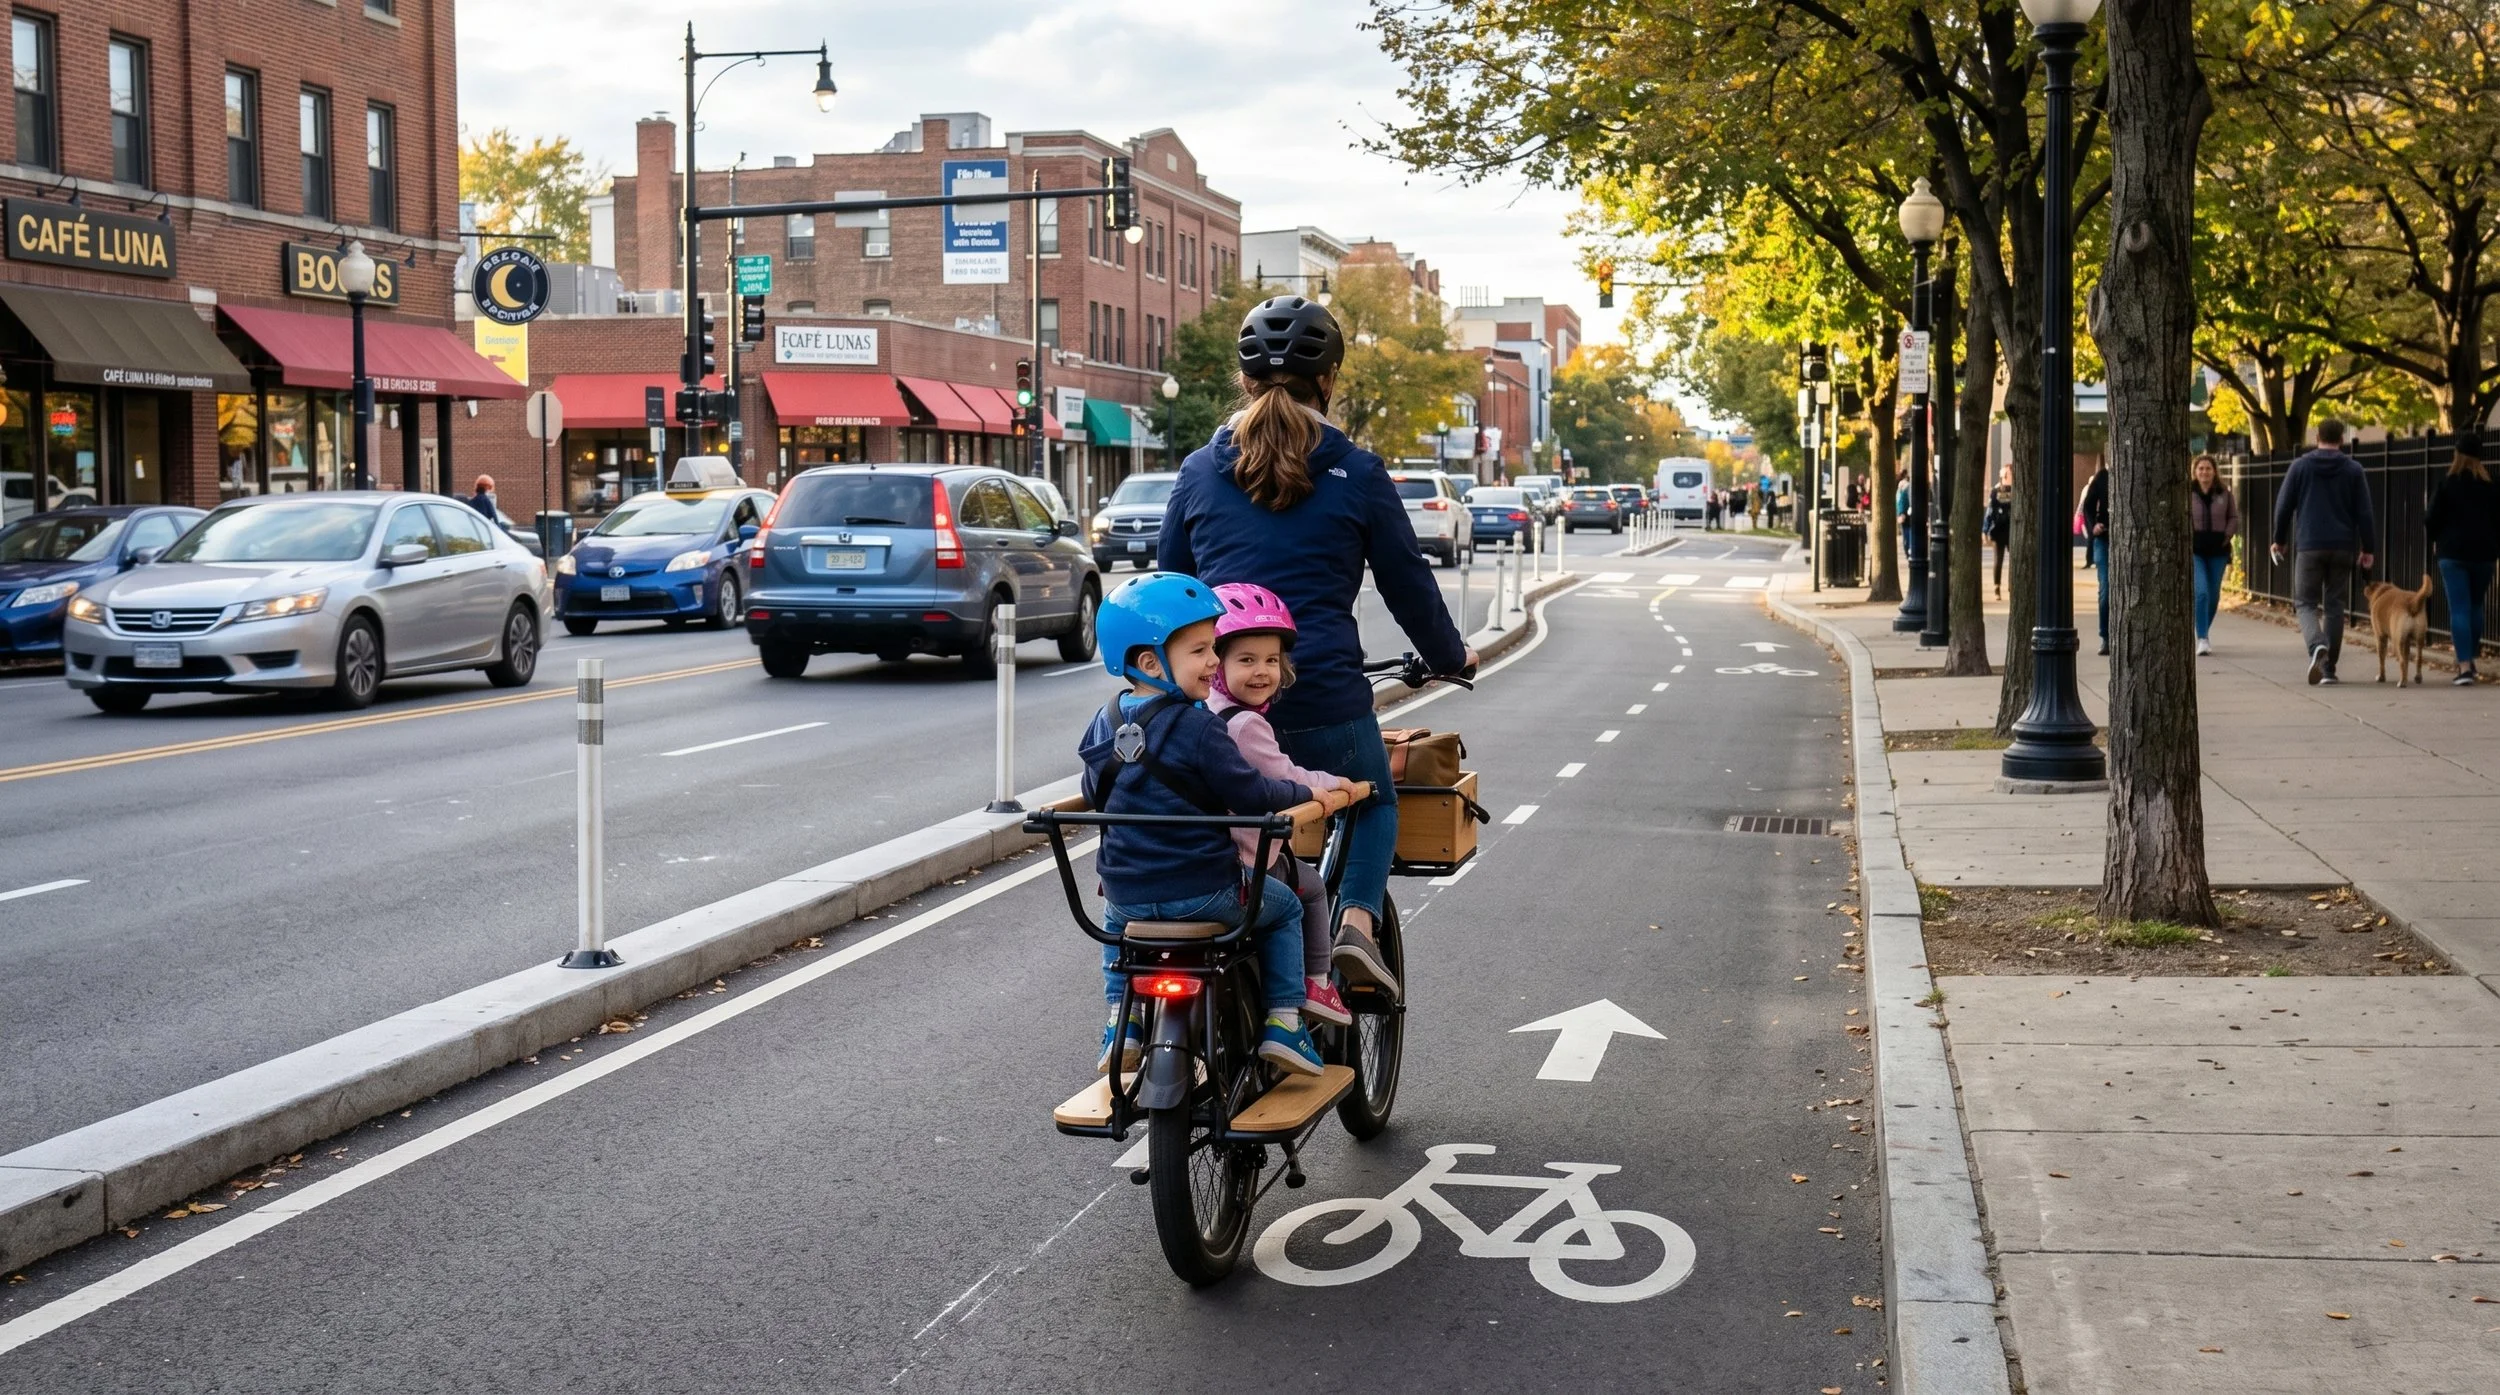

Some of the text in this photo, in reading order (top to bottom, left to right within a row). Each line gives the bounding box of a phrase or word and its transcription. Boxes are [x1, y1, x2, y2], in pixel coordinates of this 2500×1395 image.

[18, 213, 168, 268] CAFÉ LUNA
[297, 252, 393, 298] BOS
[826, 334, 871, 350] LUNAS
[103, 368, 124, 383] CAFÉ
